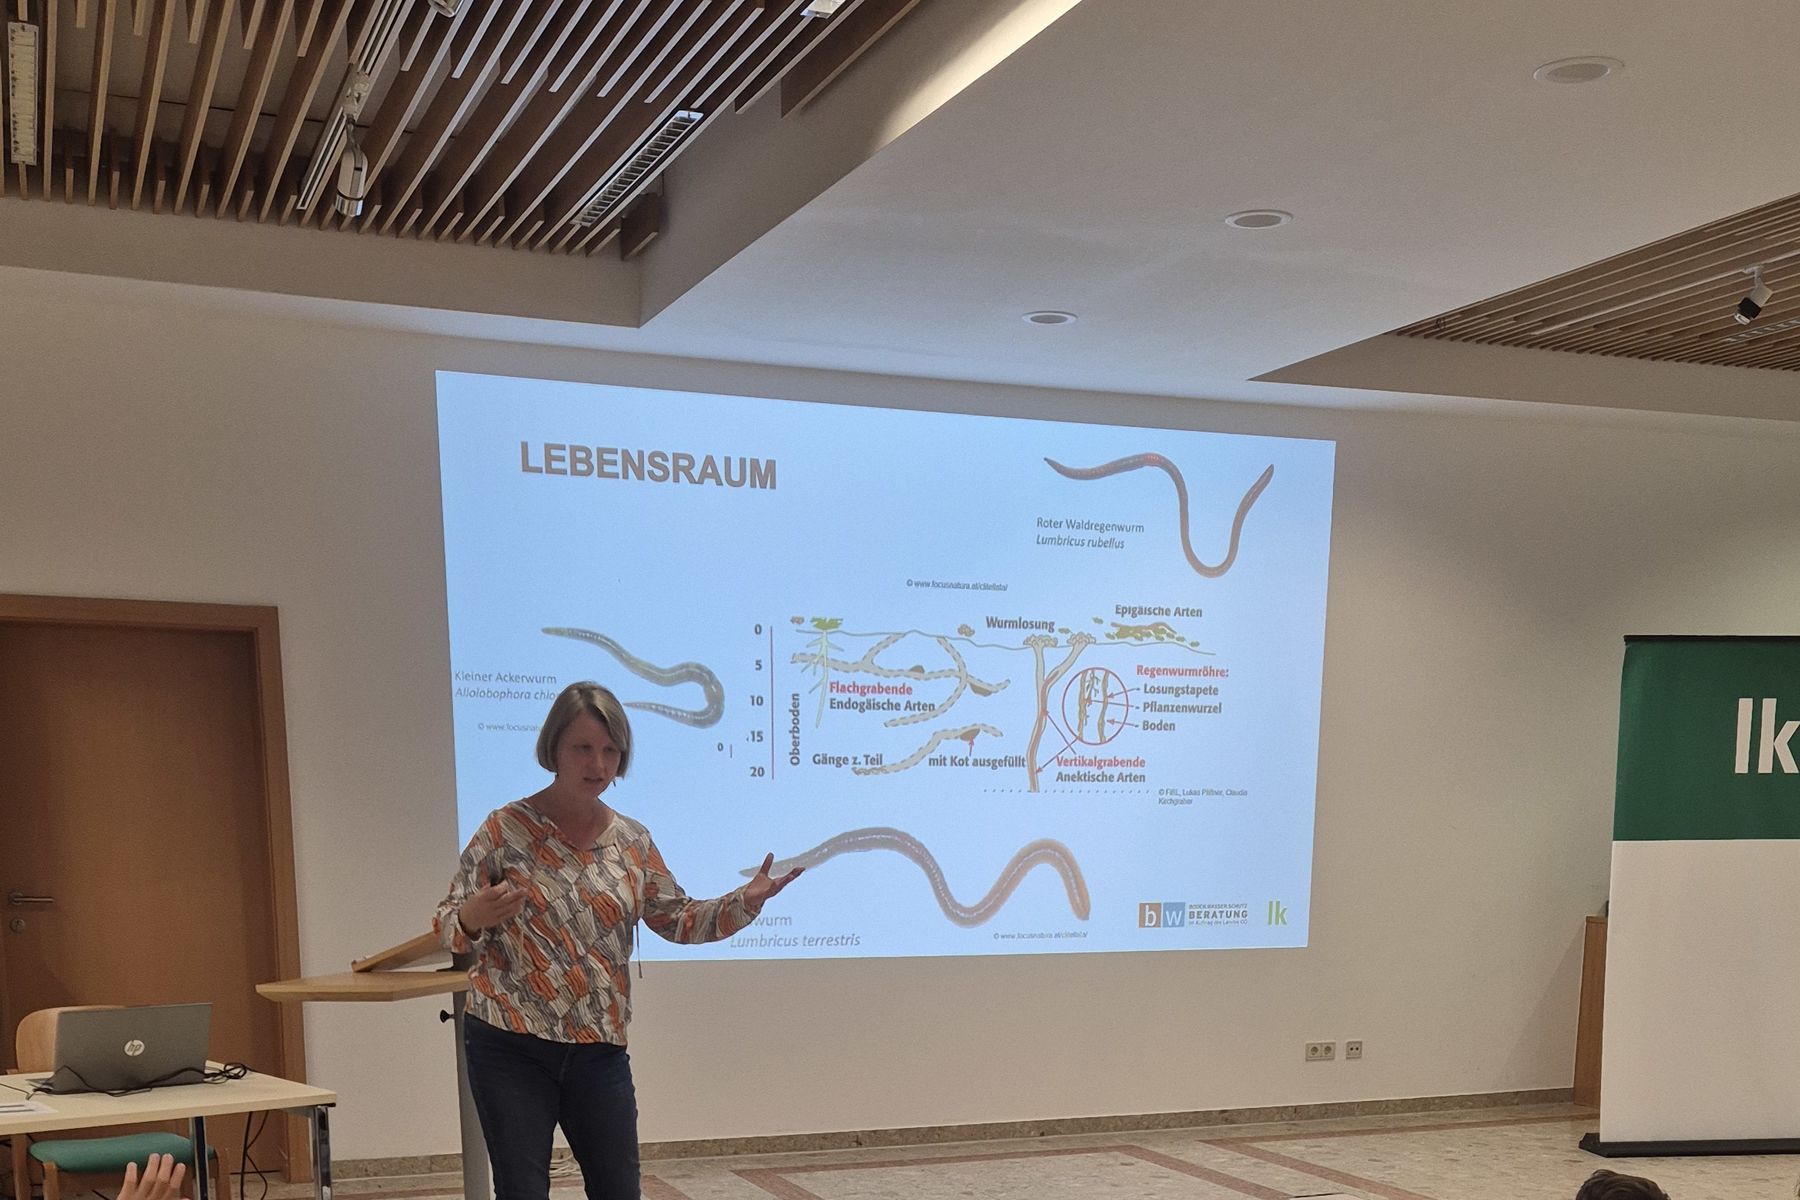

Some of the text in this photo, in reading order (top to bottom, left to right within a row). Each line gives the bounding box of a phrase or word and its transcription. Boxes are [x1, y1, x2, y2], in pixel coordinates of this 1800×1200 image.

[520, 440, 777, 490] LEBENSRAUM
[1036, 516, 1144, 534] Roter Waldregenwurm
[1036, 533, 1125, 549] Lumbricus rubellus
[1114, 604, 1203, 618] Epigäische Arten
[754, 624, 762, 635] 0
[986, 616, 1055, 632] Wurmlosung
[755, 659, 762, 671] 5
[1136, 664, 1230, 678] Regenwurmröhre:
[455, 671, 557, 684] Kleiner Ackerwurm
[455, 687, 557, 701] Allolobophora chlo
[829, 681, 913, 696] Flachgrabende
[1143, 683, 1219, 699] Losungstapete
[750, 695, 764, 706] 10
[829, 698, 936, 713] Endogäische Arten
[1142, 701, 1222, 714] Pflanzenwurzel
[789, 693, 800, 766] Oberboden
[1142, 720, 1176, 731] Boden
[750, 731, 764, 743] 15
[1735, 697, 1800, 774] lk
[812, 753, 1026, 771] Gänge z. Teil mit Kot ausgefüllt
[1056, 756, 1146, 770] Vertikalgrabende
[750, 766, 765, 778] 20
[1056, 771, 1146, 784] Anektische Arten
[1189, 910, 1249, 920] BERATUNG
[1268, 901, 1288, 926] lk
[754, 916, 792, 926] wurm
[730, 933, 861, 948] Lumbricus terrestris
